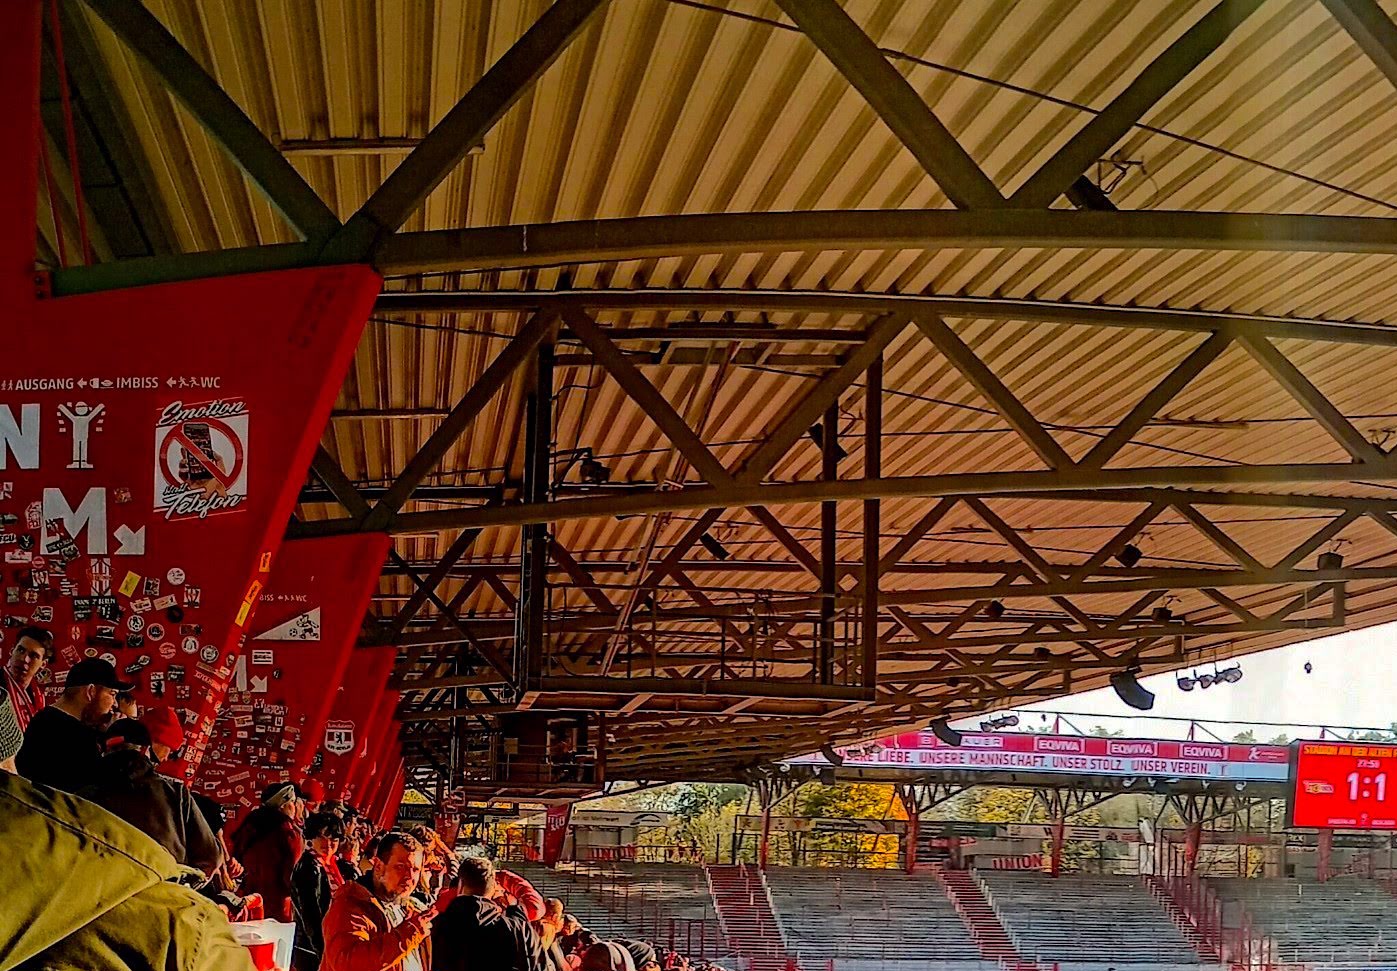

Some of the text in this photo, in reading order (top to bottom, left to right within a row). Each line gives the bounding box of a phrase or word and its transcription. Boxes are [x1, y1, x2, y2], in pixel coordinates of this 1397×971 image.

[15, 377, 74, 391] AUSGANG
[116, 377, 159, 389] IMBISS
[200, 376, 221, 389] WC
[158, 399, 246, 425] Emotion
[163, 492, 243, 520] Telefon
[878, 751, 914, 763] LIEBE.
[919, 752, 964, 764] UNSERE
[969, 754, 1047, 767] MANNSCHAFT.
[1053, 757, 1087, 769] UNSER
[1131, 759, 1167, 772] UNSER
[1171, 761, 1211, 774] VEREIN.
[1347, 772, 1387, 801] 1:1
